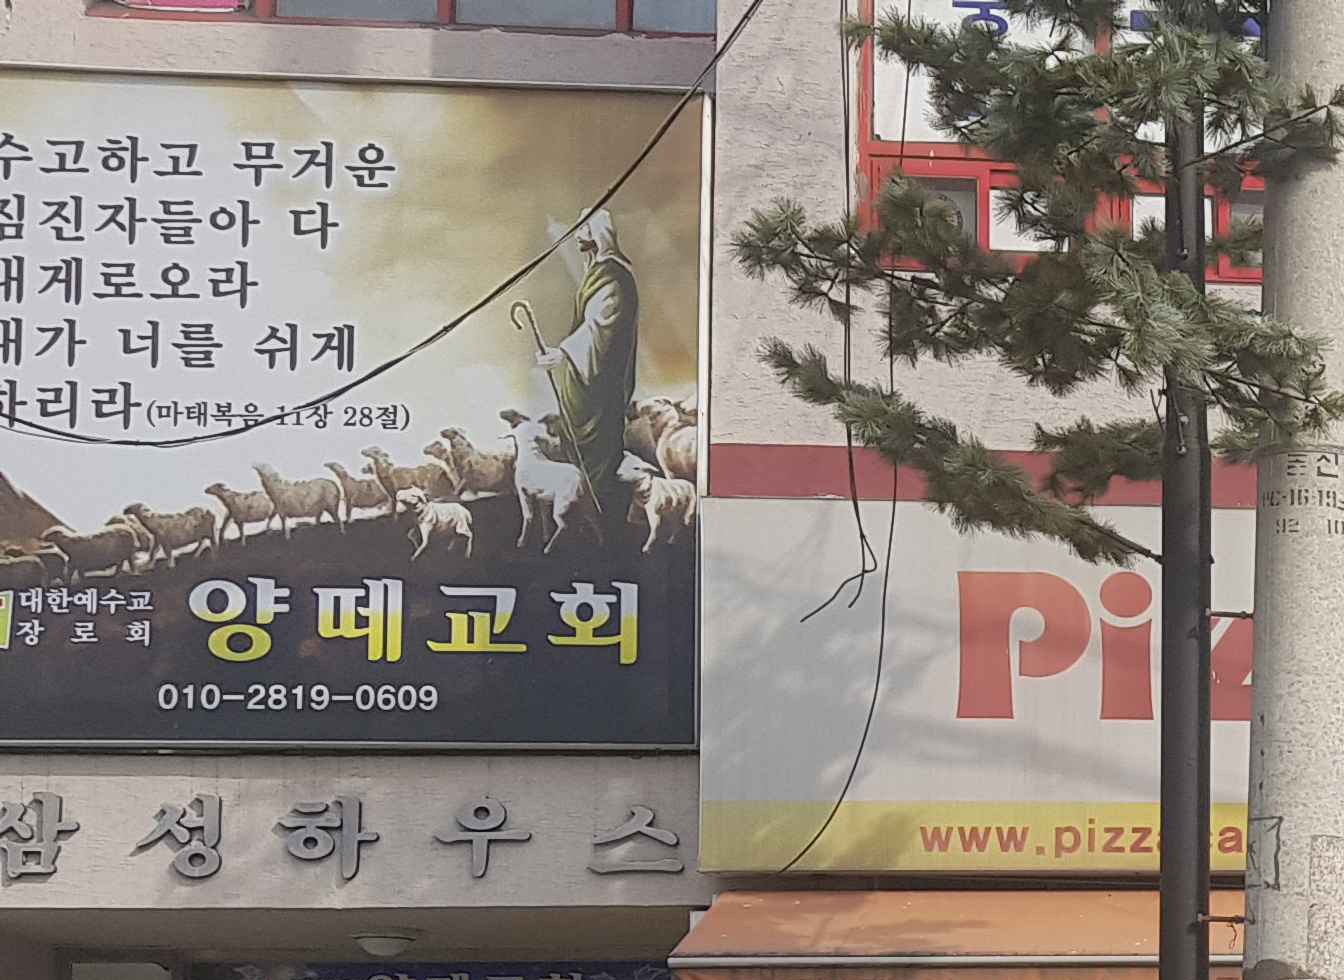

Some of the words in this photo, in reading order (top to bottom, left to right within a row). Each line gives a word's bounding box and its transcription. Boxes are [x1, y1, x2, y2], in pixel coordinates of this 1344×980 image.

[232, 139, 398, 190] 무거운
[289, 202, 340, 250] 다
[118, 319, 224, 369] 너를
[253, 322, 358, 373] 쉬게
[342, 403, 412, 433] 28절)
[18, 587, 154, 614] 대한예수교
[156, 682, 440, 711] 010-2819-0609
